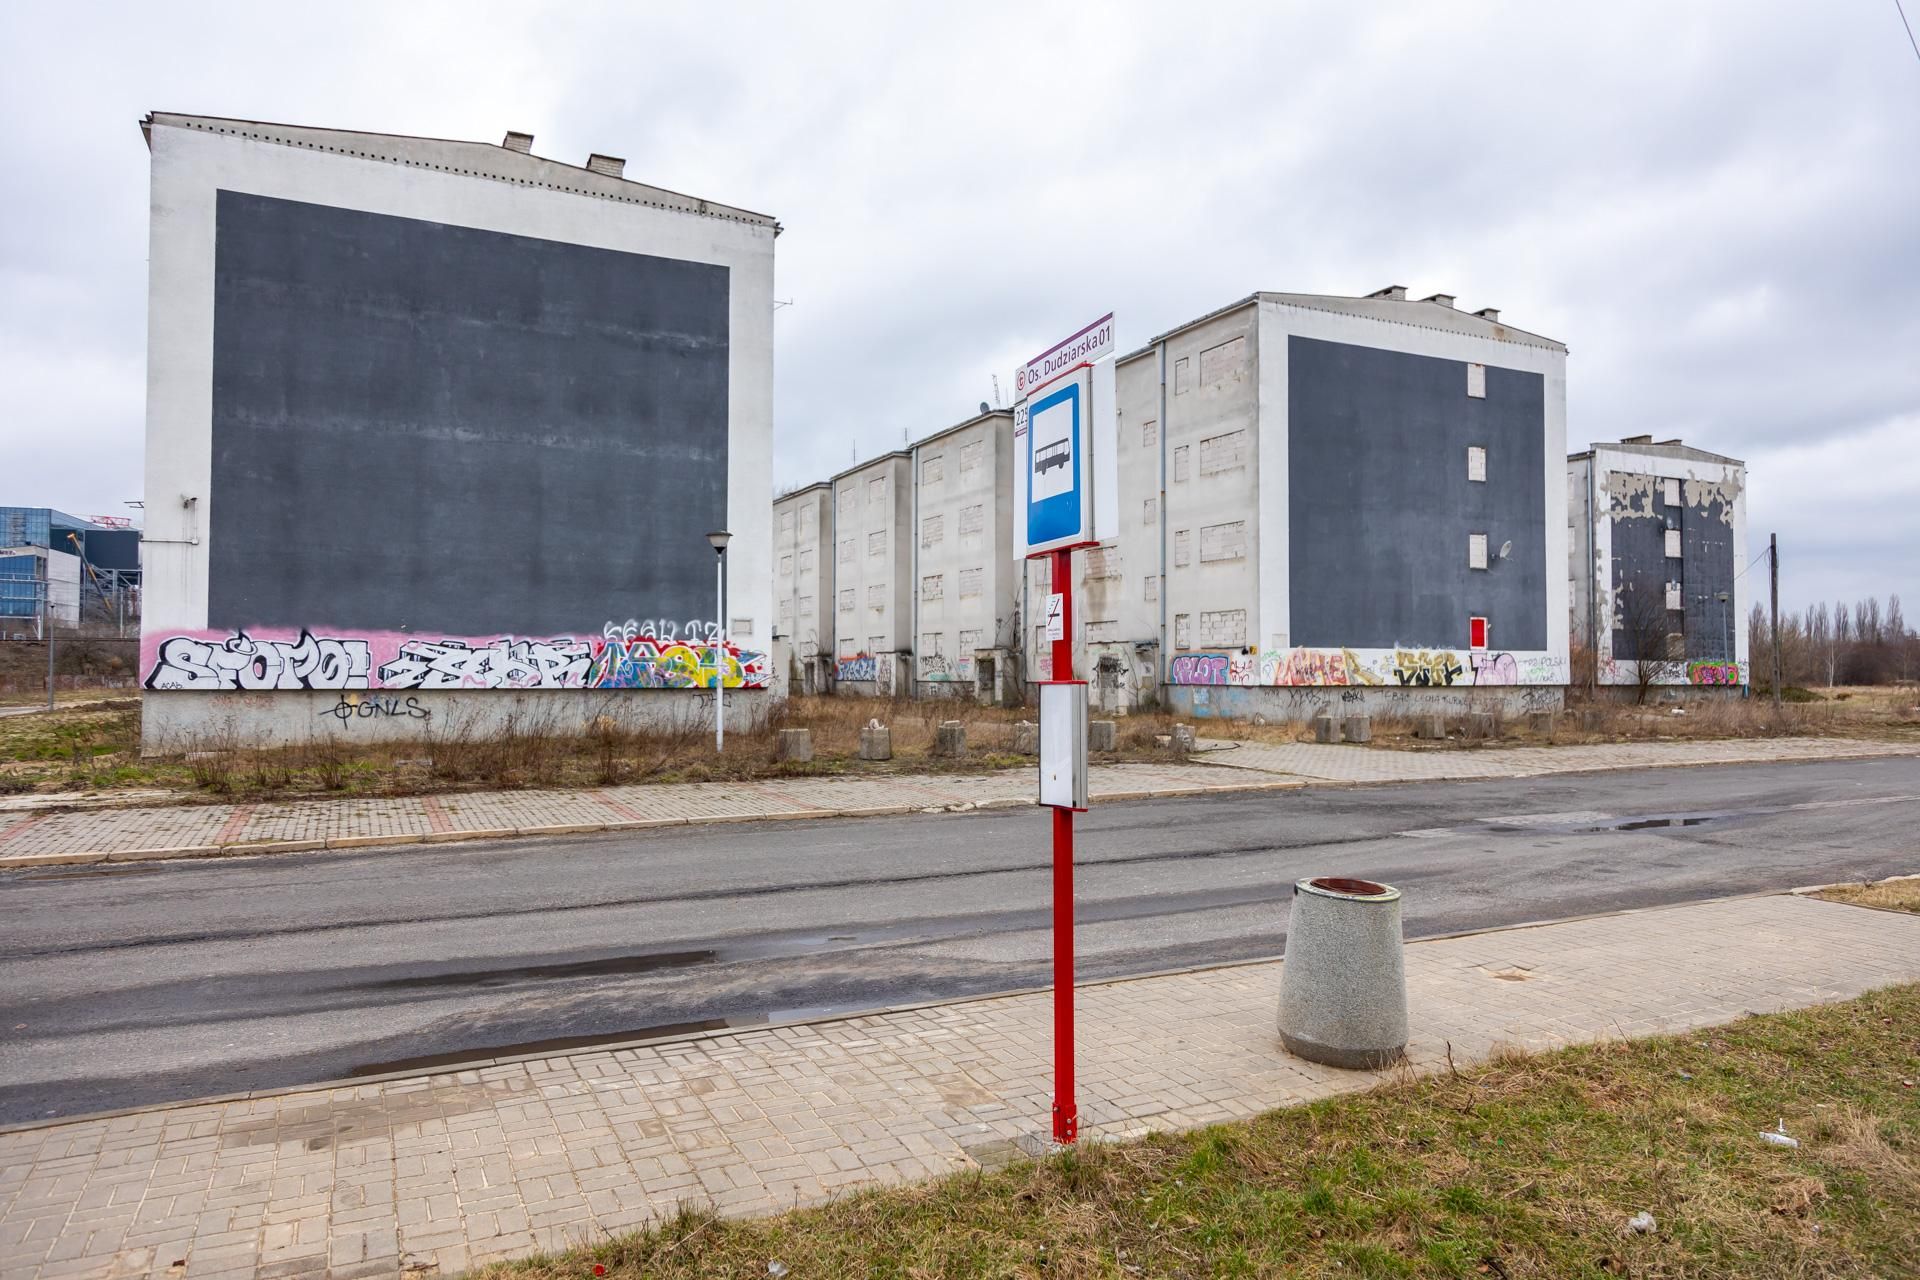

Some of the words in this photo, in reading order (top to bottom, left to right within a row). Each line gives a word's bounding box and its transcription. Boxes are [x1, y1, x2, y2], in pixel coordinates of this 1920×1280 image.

[1028, 368, 1042, 384] Os.
[1044, 335, 1098, 376] Dudziarska
[1099, 325, 1111, 346] 01
